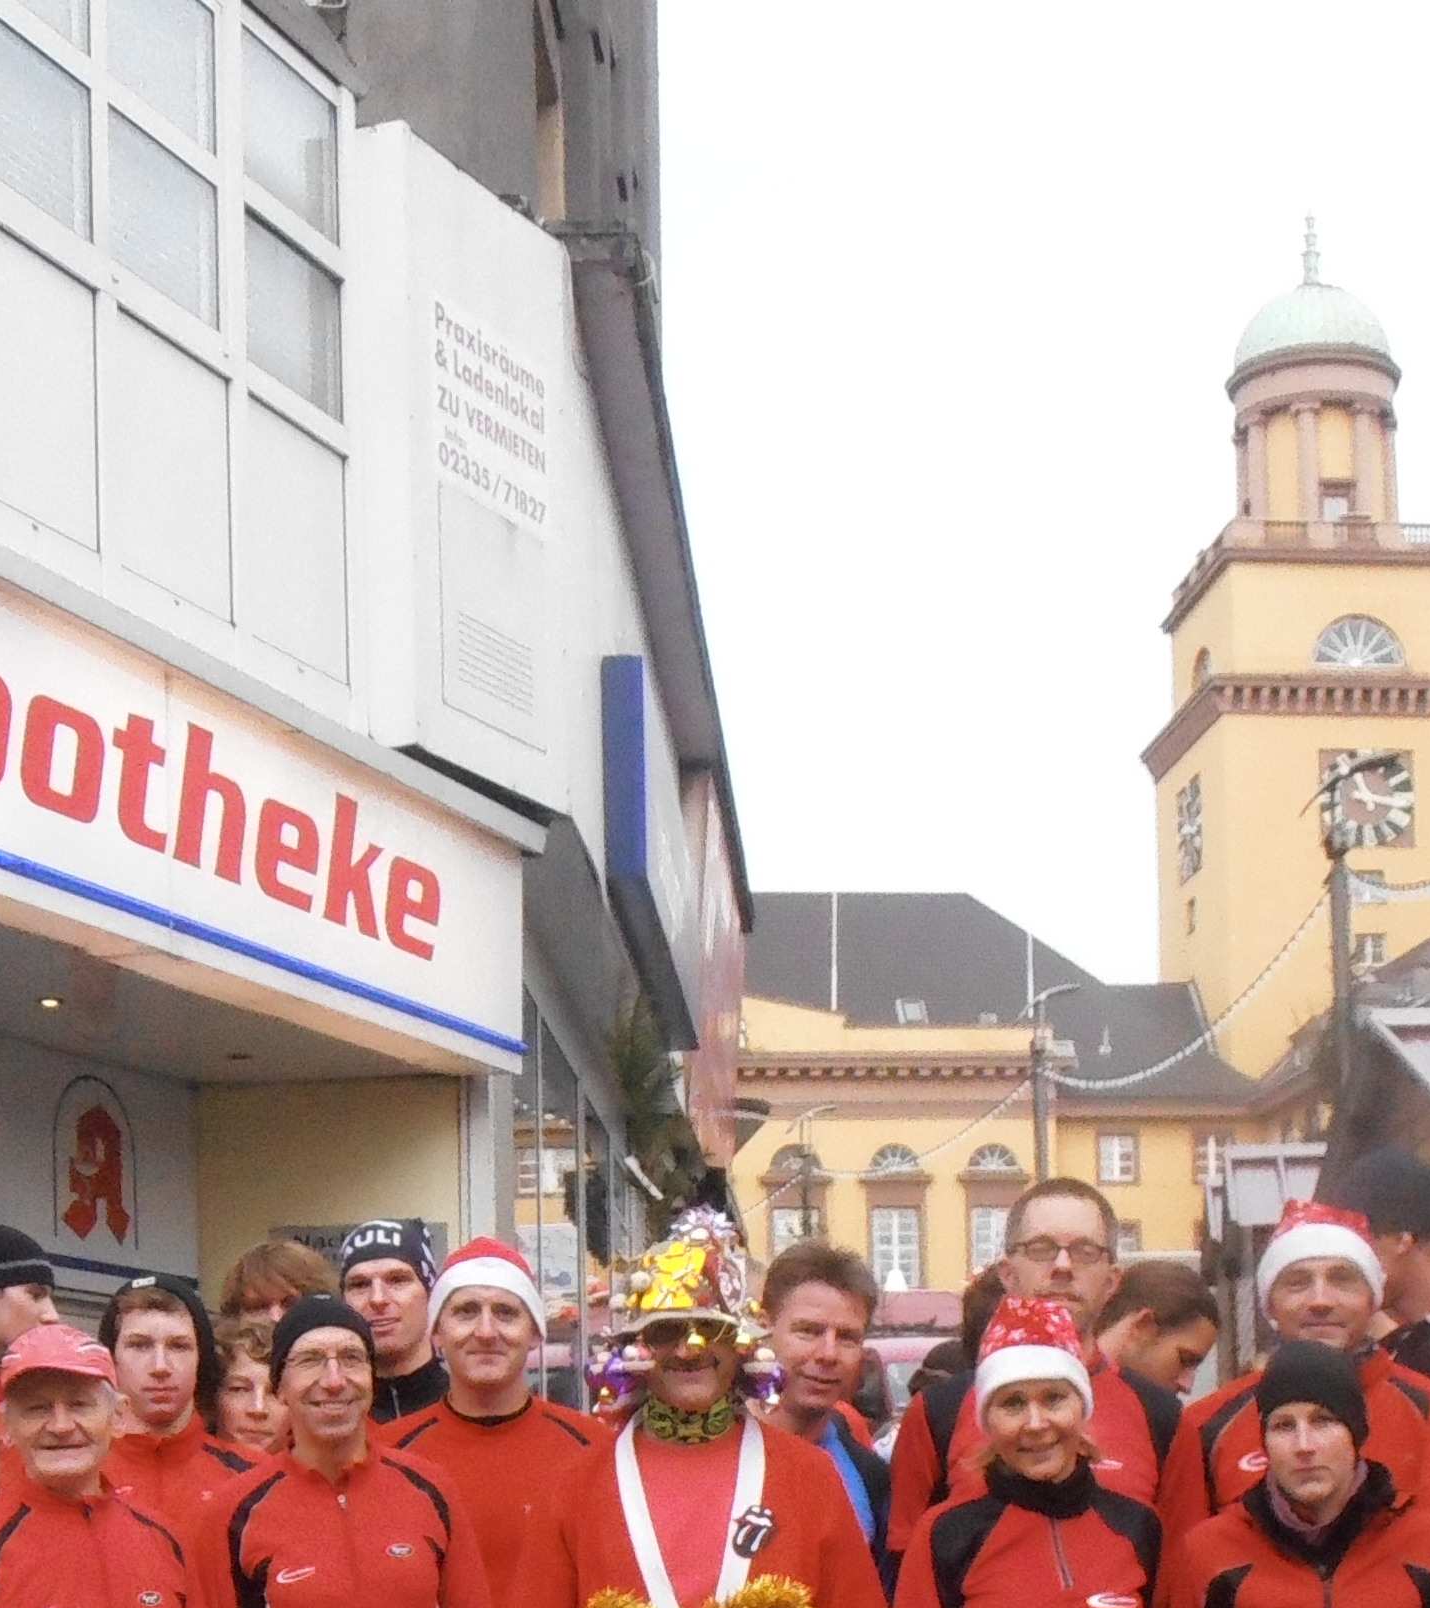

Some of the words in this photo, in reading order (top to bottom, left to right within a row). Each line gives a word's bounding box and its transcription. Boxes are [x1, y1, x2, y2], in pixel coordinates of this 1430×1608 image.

[434, 301, 545, 400] Praxisräume
[434, 338, 449, 374] &
[453, 348, 545, 435] Ladenlokal
[437, 384, 460, 419] ZU
[464, 400, 546, 475] VERMIETEN
